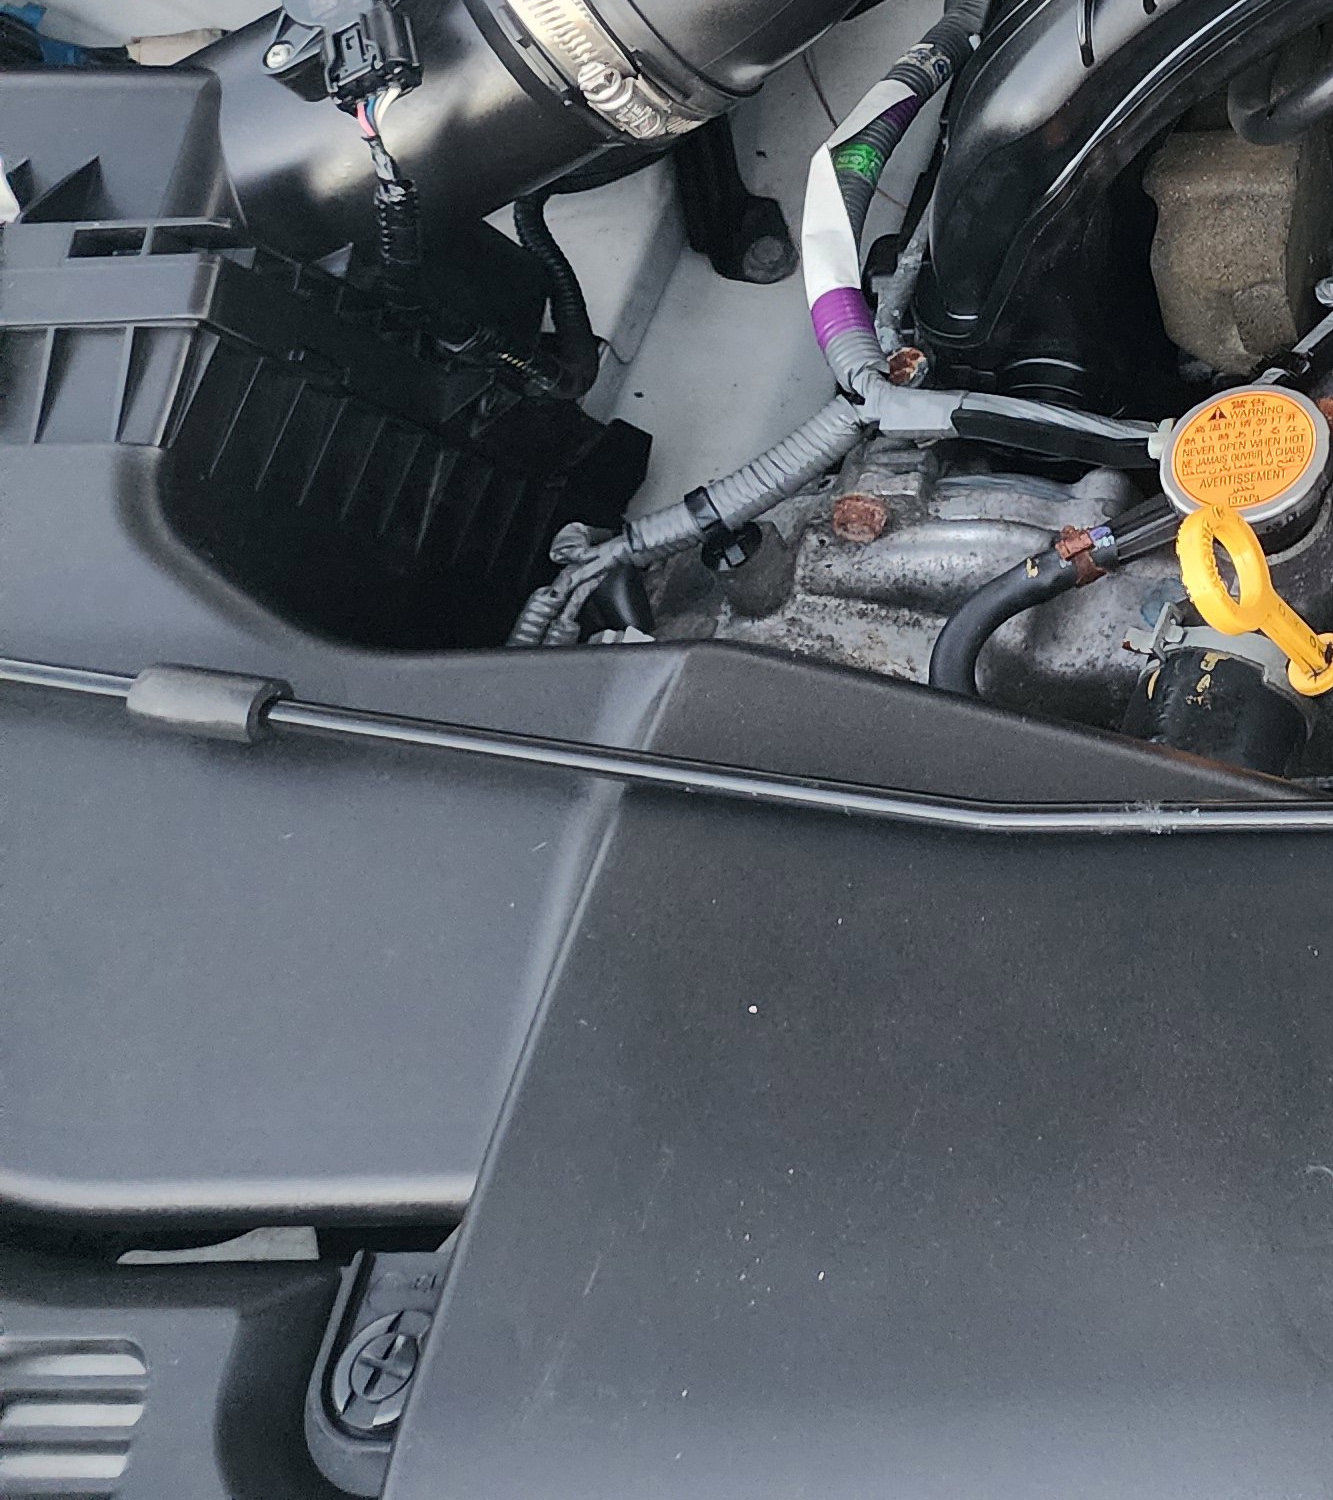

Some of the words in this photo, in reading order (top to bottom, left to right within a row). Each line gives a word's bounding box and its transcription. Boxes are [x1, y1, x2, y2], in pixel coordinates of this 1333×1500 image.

[1229, 405, 1284, 419] WARNING
[1182, 457, 1192, 469] NE
[1196, 454, 1228, 467] JAMAIS
[1230, 449, 1263, 463] OUVRIR
[1275, 445, 1306, 457] CHAUD
[1183, 445, 1215, 459] NEVER
[1219, 441, 1247, 453] OPEN
[1249, 436, 1281, 449] WHEN
[1284, 433, 1306, 445] HOT
[1200, 469, 1287, 490] AVERTISSEMENT
